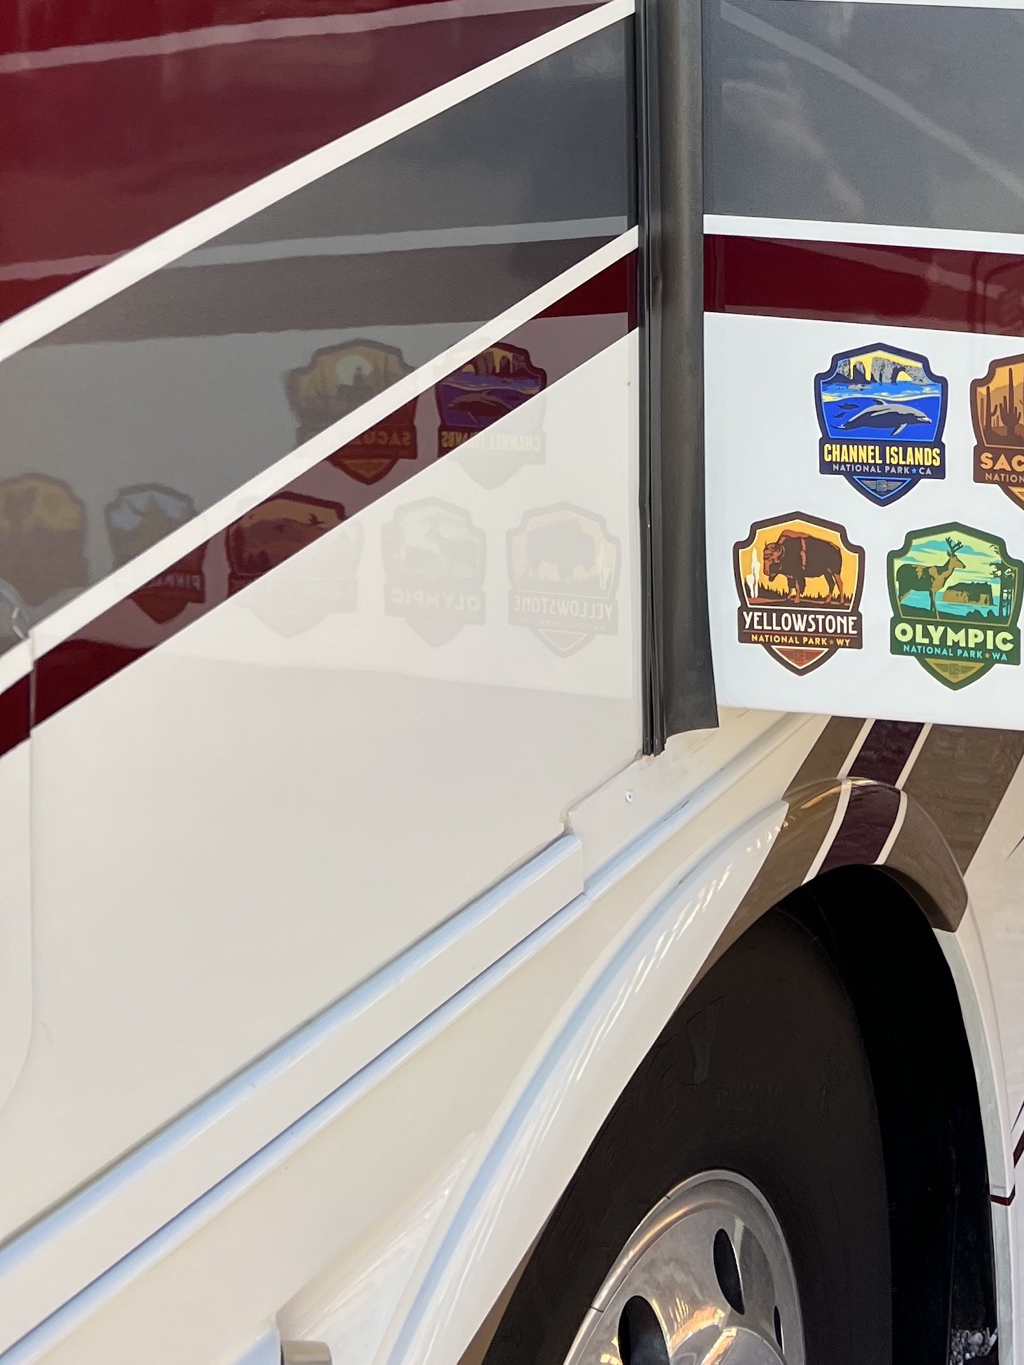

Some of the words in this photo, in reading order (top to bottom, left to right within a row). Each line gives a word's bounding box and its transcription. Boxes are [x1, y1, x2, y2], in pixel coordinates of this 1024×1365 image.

[824, 443, 882, 464] CHANNEL
[885, 446, 940, 466] ISLANDS
[832, 464, 881, 473] NATIONAL
[885, 465, 909, 474] PARK
[919, 467, 931, 475] CA
[742, 611, 858, 634] YELLOWSTONE
[751, 634, 800, 644] NATIONAL
[803, 636, 827, 645] PARK
[836, 638, 851, 647] WY
[894, 622, 1014, 651] OLYMPIC
[903, 644, 953, 656] NATIONAL
[957, 649, 983, 659] PARK
[992, 652, 1008, 661] WA
